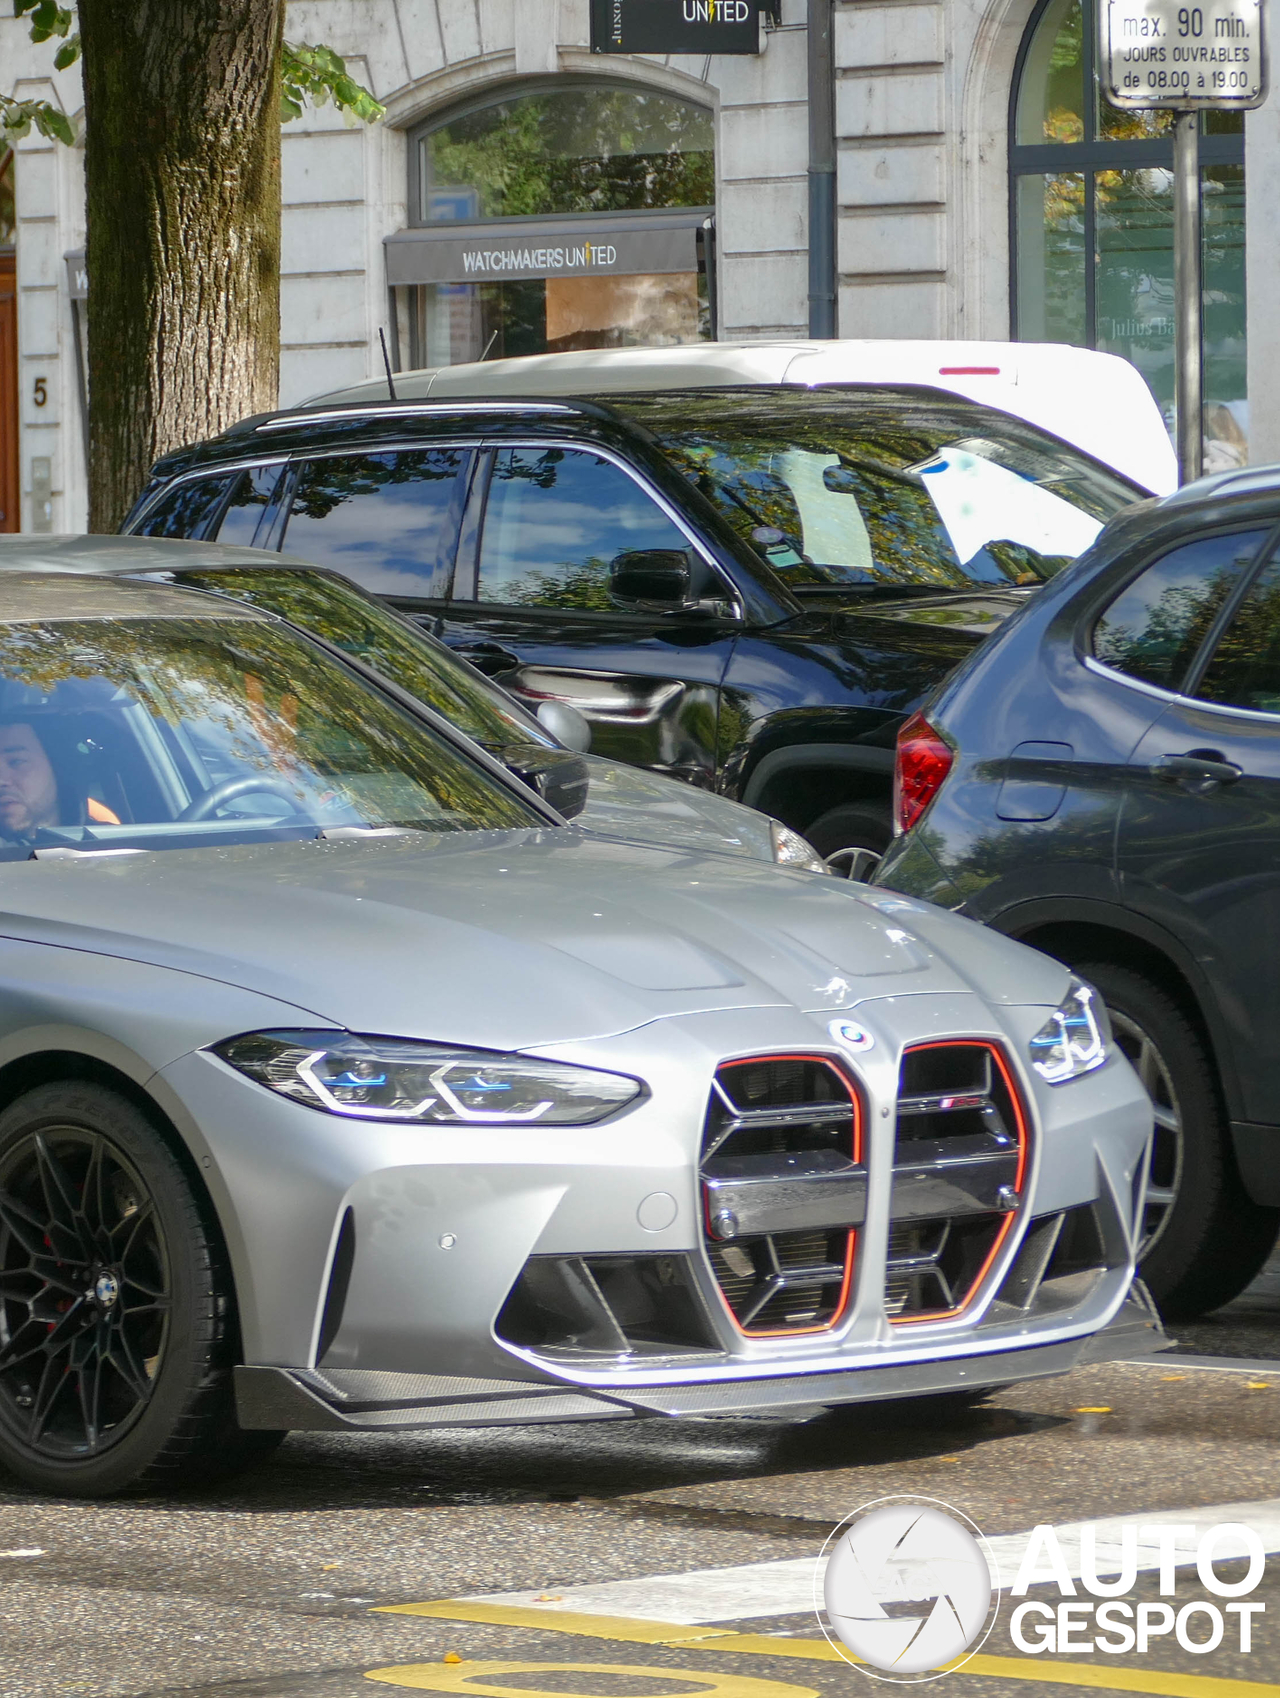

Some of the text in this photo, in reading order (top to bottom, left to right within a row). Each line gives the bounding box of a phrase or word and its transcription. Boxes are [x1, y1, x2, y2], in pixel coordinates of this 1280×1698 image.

[1123, 8, 1250, 38] max. 90 min.
[1123, 47, 1250, 62] JOURS OUVRABLES
[1123, 71, 1248, 88] de 08.00 à 19.00
[463, 241, 617, 273] WATCHMAKERS UNITED
[1112, 318, 1153, 340] Julius
[34, 377, 48, 407] 5
